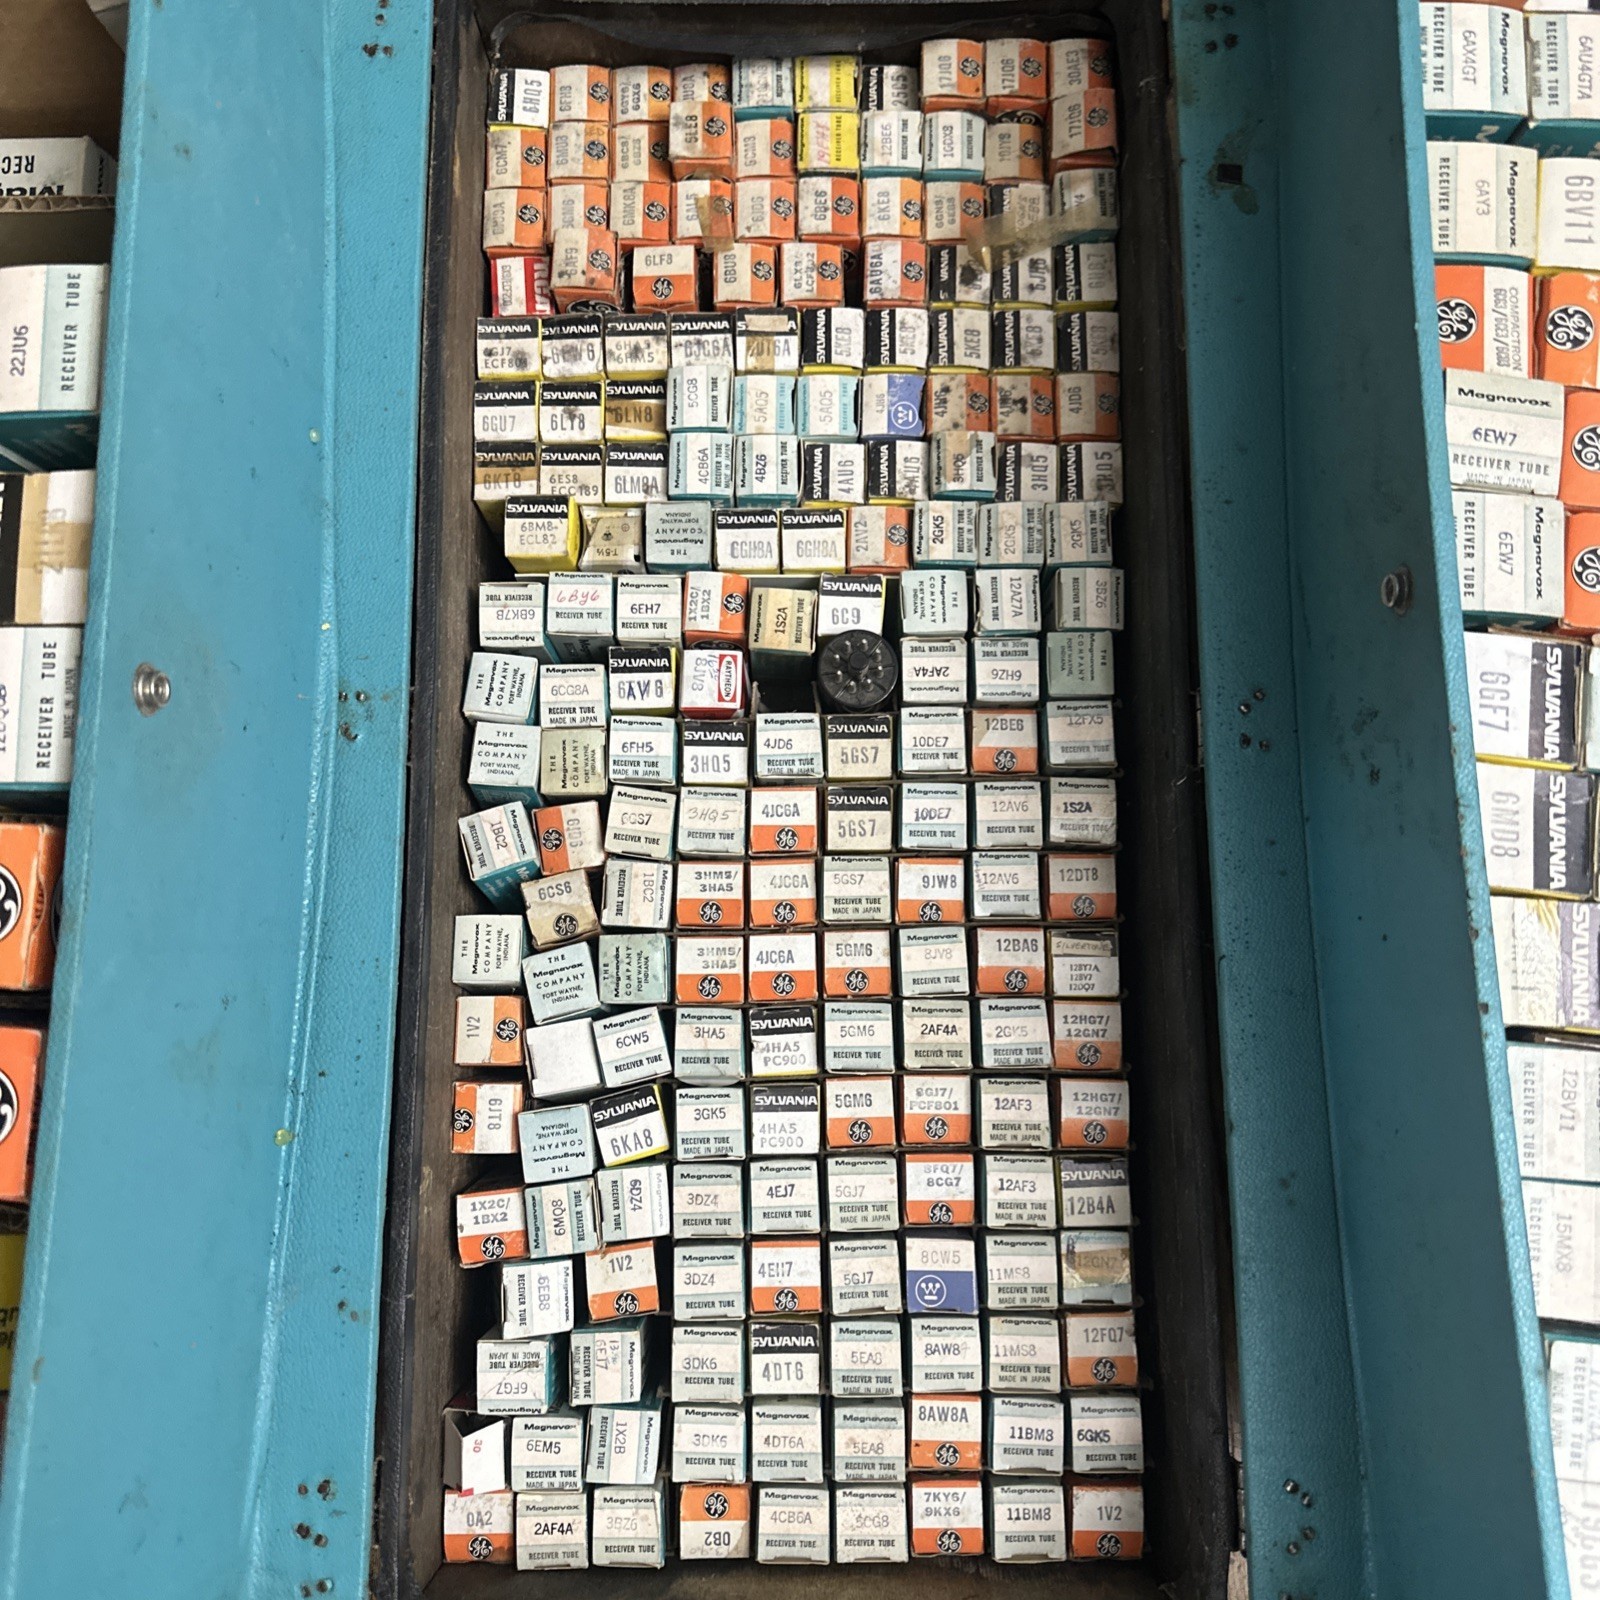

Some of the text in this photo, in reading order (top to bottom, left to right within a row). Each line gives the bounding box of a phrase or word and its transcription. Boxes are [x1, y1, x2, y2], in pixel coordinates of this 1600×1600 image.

[1433, 7, 1444, 92] RECEIVER TUBE
[1462, 30, 1476, 85] 6AX4GT
[1501, 12, 1510, 95] Magnavox
[1577, 36, 1593, 100] 6AU4GTA
[498, 72, 508, 122] SYLVANIA
[1476, 180, 1490, 216] 6AY3
[1565, 175, 1594, 244] 6BV11
[61, 273, 81, 391] RECEIVER TUBE
[478, 324, 531, 333] SYLVANIA
[609, 322, 665, 331] SYLVANIA
[671, 321, 730, 330] SYLVANIA
[1509, 287, 1522, 371] COMPACTRON
[817, 309, 825, 363] SYLVANIA
[939, 313, 947, 364] SYLVANIA
[10, 325, 28, 376] 22JU6
[474, 391, 529, 400] SYLVANIA
[543, 391, 598, 400] SYLVANIA
[606, 385, 664, 395] SYLVANIA
[688, 378, 698, 408] 5CG8
[1458, 387, 1551, 408] Magnavox
[482, 415, 516, 432] 6GU7
[1472, 427, 1517, 446] 6EW7
[541, 452, 600, 461] SYLVANIA
[609, 451, 664, 461] SYLVANIA
[698, 447, 708, 484] 4CB6A
[755, 454, 766, 483] 4BZ6
[1453, 454, 1550, 476] RECEIVER TUBE
[549, 475, 578, 484] 6ES8
[814, 448, 823, 499] SYLVANIA
[507, 504, 567, 513] SYLVANIA
[718, 515, 776, 524] SYLVANIA
[782, 514, 842, 524] SYLVANIA
[932, 516, 944, 545] 2GK5
[1071, 519, 1082, 549] 2GK5
[1464, 501, 1475, 597] RECEIVER TUBE
[1498, 532, 1513, 576] 6EW7
[1532, 507, 1544, 599] Magnavox
[823, 581, 882, 593] SYLVANIA
[1009, 576, 1022, 618] 12AZ7A
[587, 611, 602, 619] TUBE
[630, 603, 661, 615] 6EH7
[831, 608, 860, 625] 6C9
[653, 621, 667, 629] TUBE
[775, 607, 787, 635] 1S2A
[610, 657, 668, 668] SYLVANIA
[913, 666, 950, 677] 2AF4A
[991, 668, 1022, 680] 6HZ6
[496, 661, 509, 706] COMPANY
[551, 684, 589, 695] 6CG8A
[36, 642, 57, 768] RECEIVER TUBE
[1478, 671, 1510, 732] 6GF7
[1544, 646, 1562, 760] SYLVANIA
[984, 719, 1024, 731] 12BE6
[684, 731, 744, 741] SYLVANIA
[763, 738, 793, 750] 4JD6
[912, 735, 949, 748] 10DE7
[622, 741, 654, 753] 6FH5
[478, 751, 527, 760] COMPANY
[840, 746, 880, 765] 5GS7
[690, 754, 731, 774] 3HQ5
[992, 800, 1029, 812] 12AV6
[1062, 802, 1093, 813] 1S2A
[838, 819, 876, 838] 5GS7
[1491, 790, 1520, 859] 6MD8
[1549, 775, 1566, 890] SYLVANIA
[921, 875, 958, 889] 9JW8
[982, 873, 1019, 885] 12AV6
[1059, 869, 1099, 882] 12DT8
[538, 881, 572, 901] 6CS6
[836, 943, 873, 957] 5GM6
[997, 938, 1039, 953] 12BA6
[1572, 905, 1590, 1024] SYLVANIA
[536, 972, 586, 989] COMPANY
[466, 1016, 481, 1039] 1V2
[920, 1023, 958, 1036] 2AF4A
[1066, 1027, 1108, 1038] 12GN7
[616, 1031, 650, 1049] 6CW5
[994, 1098, 1032, 1110] 12AF3
[1559, 1069, 1579, 1132] 12BV11
[488, 1098, 502, 1131] 6JT8
[694, 1108, 726, 1120] 3GK5
[611, 1129, 654, 1157] 6KA8
[926, 1176, 961, 1187] 8CG7
[766, 1185, 795, 1198] 4EJ7
[1068, 1195, 1115, 1216] 12B4A
[473, 1212, 508, 1225] 1BX2
[554, 1199, 565, 1235] 6MQ8
[609, 1255, 633, 1273] 1V2
[1083, 1328, 1124, 1343] 12FQ7
[683, 1358, 717, 1370] 3DK6
[918, 1405, 968, 1423] 8AW8A
[1010, 1427, 1054, 1441] 11BM8
[1077, 1429, 1110, 1443] 6GK5
[526, 1439, 561, 1454] 6EM5
[925, 1507, 960, 1517] 9KX6
[1007, 1508, 1051, 1521] 11BM8
[1097, 1506, 1122, 1522] 1V2
[534, 1523, 573, 1536] 2AF4A
